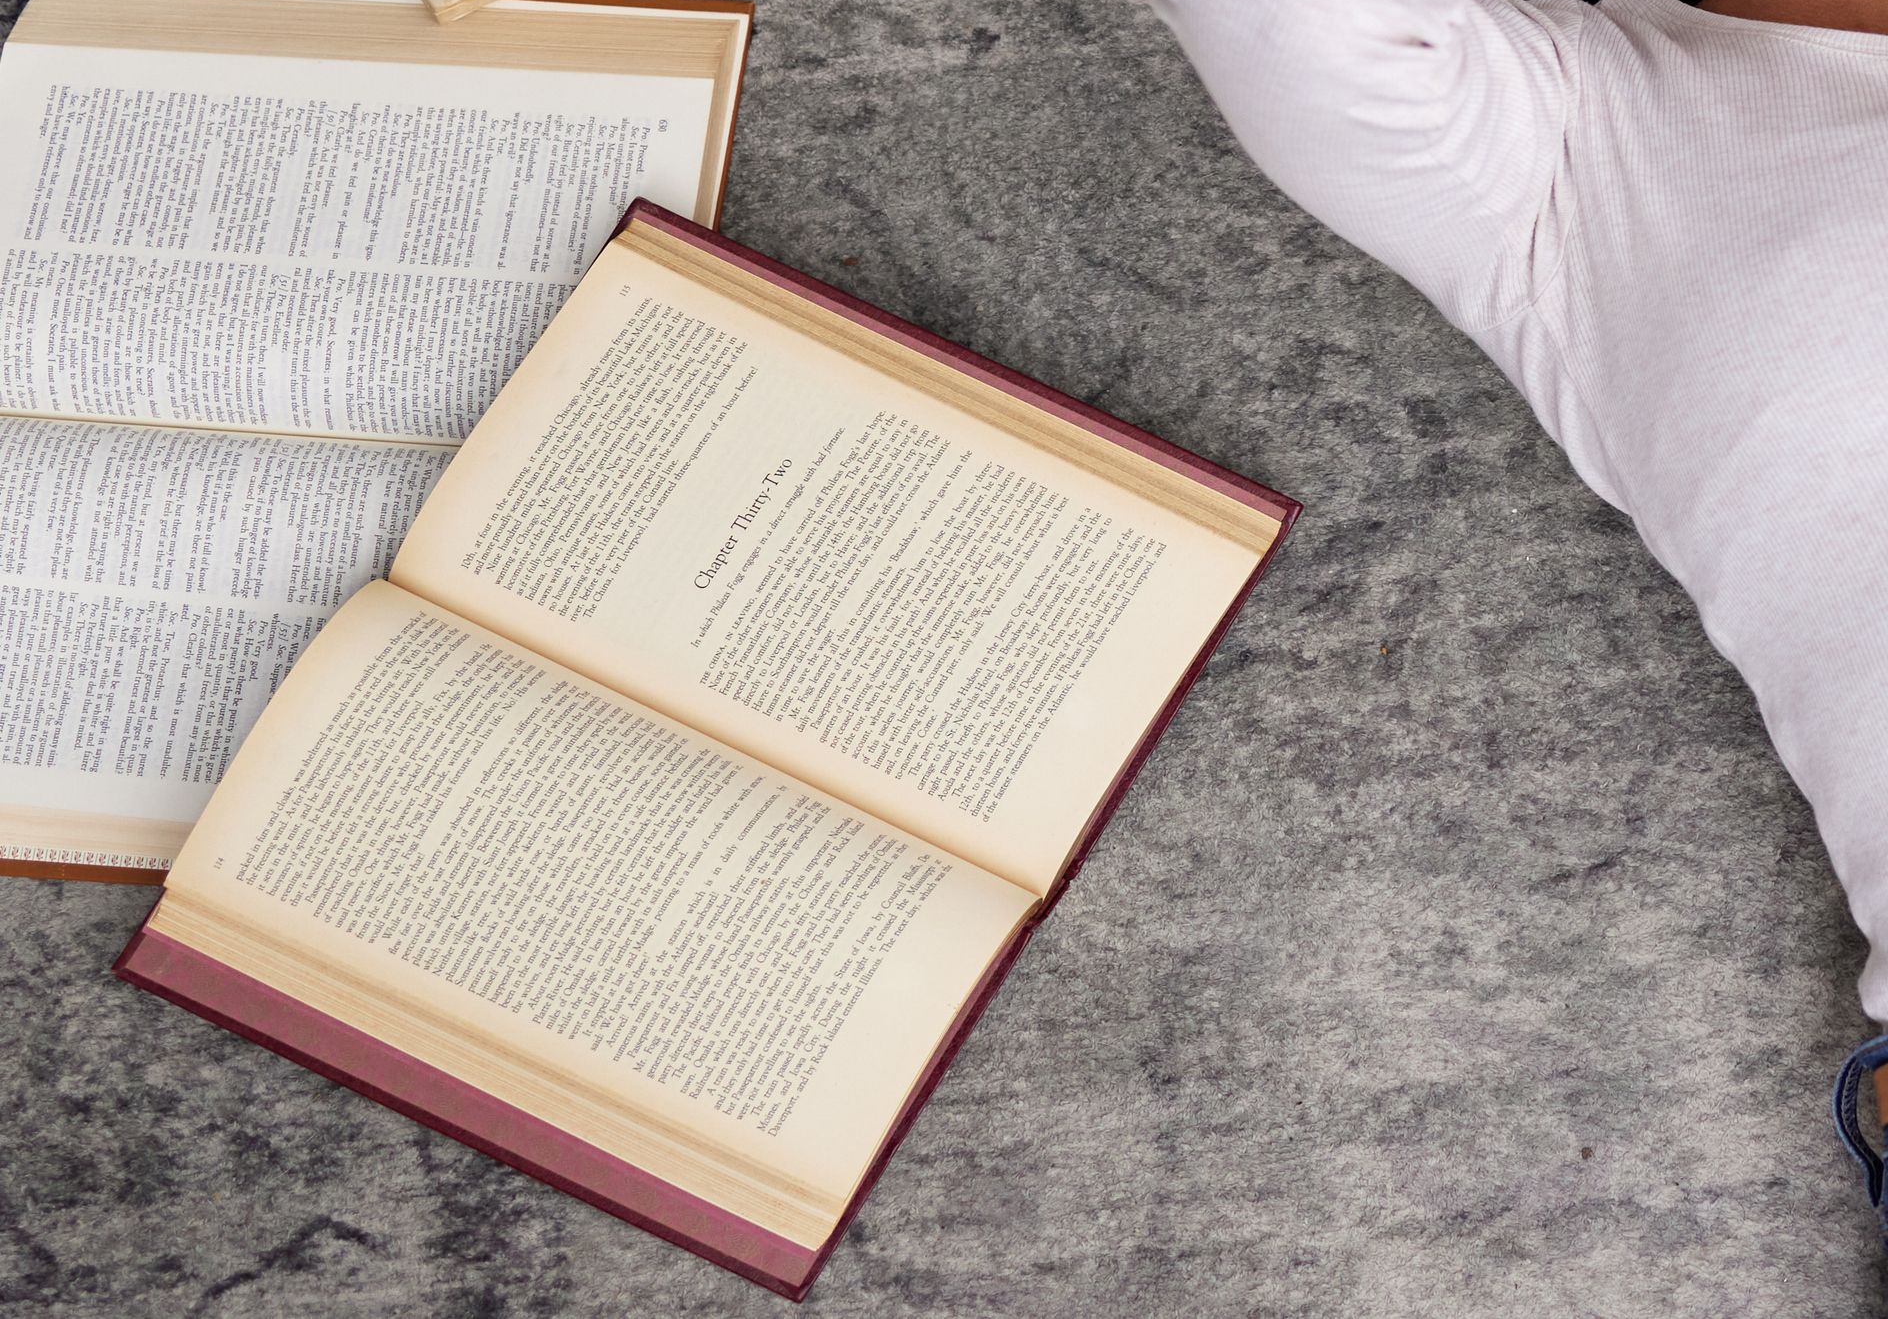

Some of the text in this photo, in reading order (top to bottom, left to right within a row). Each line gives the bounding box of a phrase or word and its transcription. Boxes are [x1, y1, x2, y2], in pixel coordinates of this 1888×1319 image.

[636, 127, 650, 172] Pro. Proceed.
[620, 285, 630, 296] 115
[583, 367, 758, 617] The China, for Liverpool, had started three-quarters of an hour before!
[694, 460, 792, 588] Chapter Thirty-Two
[699, 618, 714, 637] which
[710, 592, 730, 616] Phileas
[727, 573, 745, 590] Fogg
[742, 546, 761, 572] engages
[769, 510, 786, 529] direct
[785, 484, 805, 509] struggle
[804, 468, 816, 482] with
[812, 452, 826, 466] bad
[823, 428, 845, 454] fortune.
